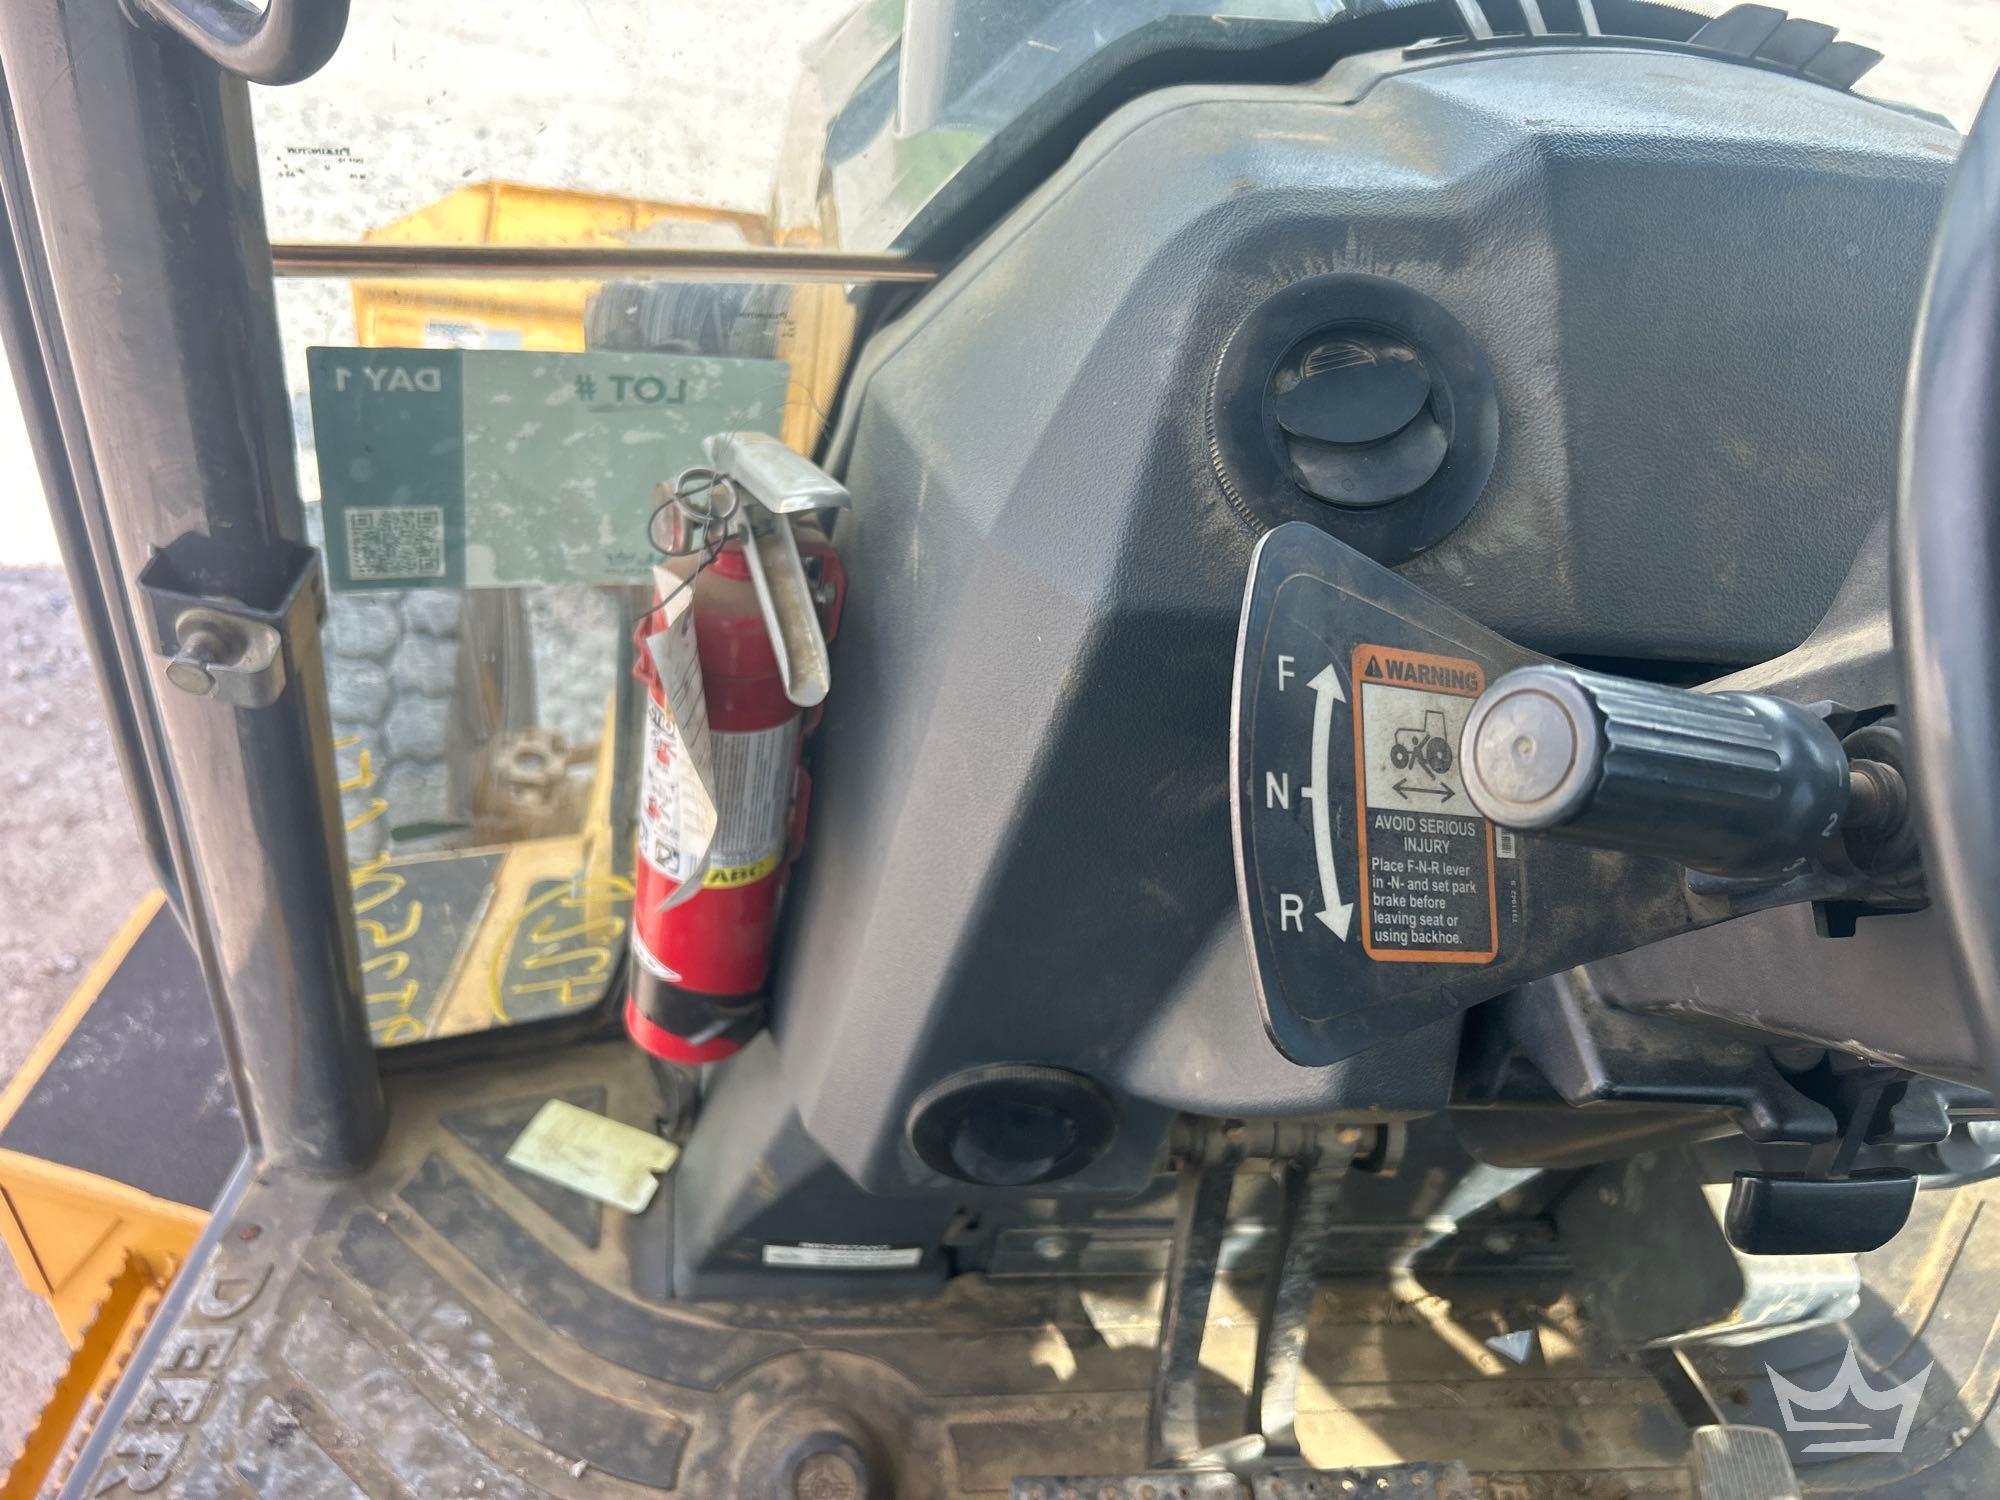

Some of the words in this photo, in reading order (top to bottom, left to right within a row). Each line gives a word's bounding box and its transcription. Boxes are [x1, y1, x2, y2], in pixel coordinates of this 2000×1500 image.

[1278, 655, 1295, 691] F
[1384, 658, 1478, 691] WARNING
[1265, 771, 1289, 810] N
[1375, 815, 1415, 832] AVOID
[1419, 818, 1476, 836] SERIOUS
[1821, 812, 1838, 836] 2
[1404, 837, 1450, 854] INJURY
[1372, 857, 1404, 872] Place
[1407, 859, 1439, 874] F-N-R
[1443, 862, 1470, 876] lever
[1372, 876, 1383, 889] in
[1387, 876, 1404, 890] -N-
[1407, 878, 1429, 891] and
[1432, 879, 1450, 892] set
[1452, 880, 1477, 895] park
[1373, 893, 1406, 907] brake
[1410, 894, 1446, 909] before
[1280, 893, 1304, 932] R
[1374, 910, 1417, 928] leaving
[1420, 913, 1445, 926] seat
[1447, 916, 1458, 927] or
[1375, 929, 1408, 946] using
[1411, 929, 1463, 945] backhoe.
